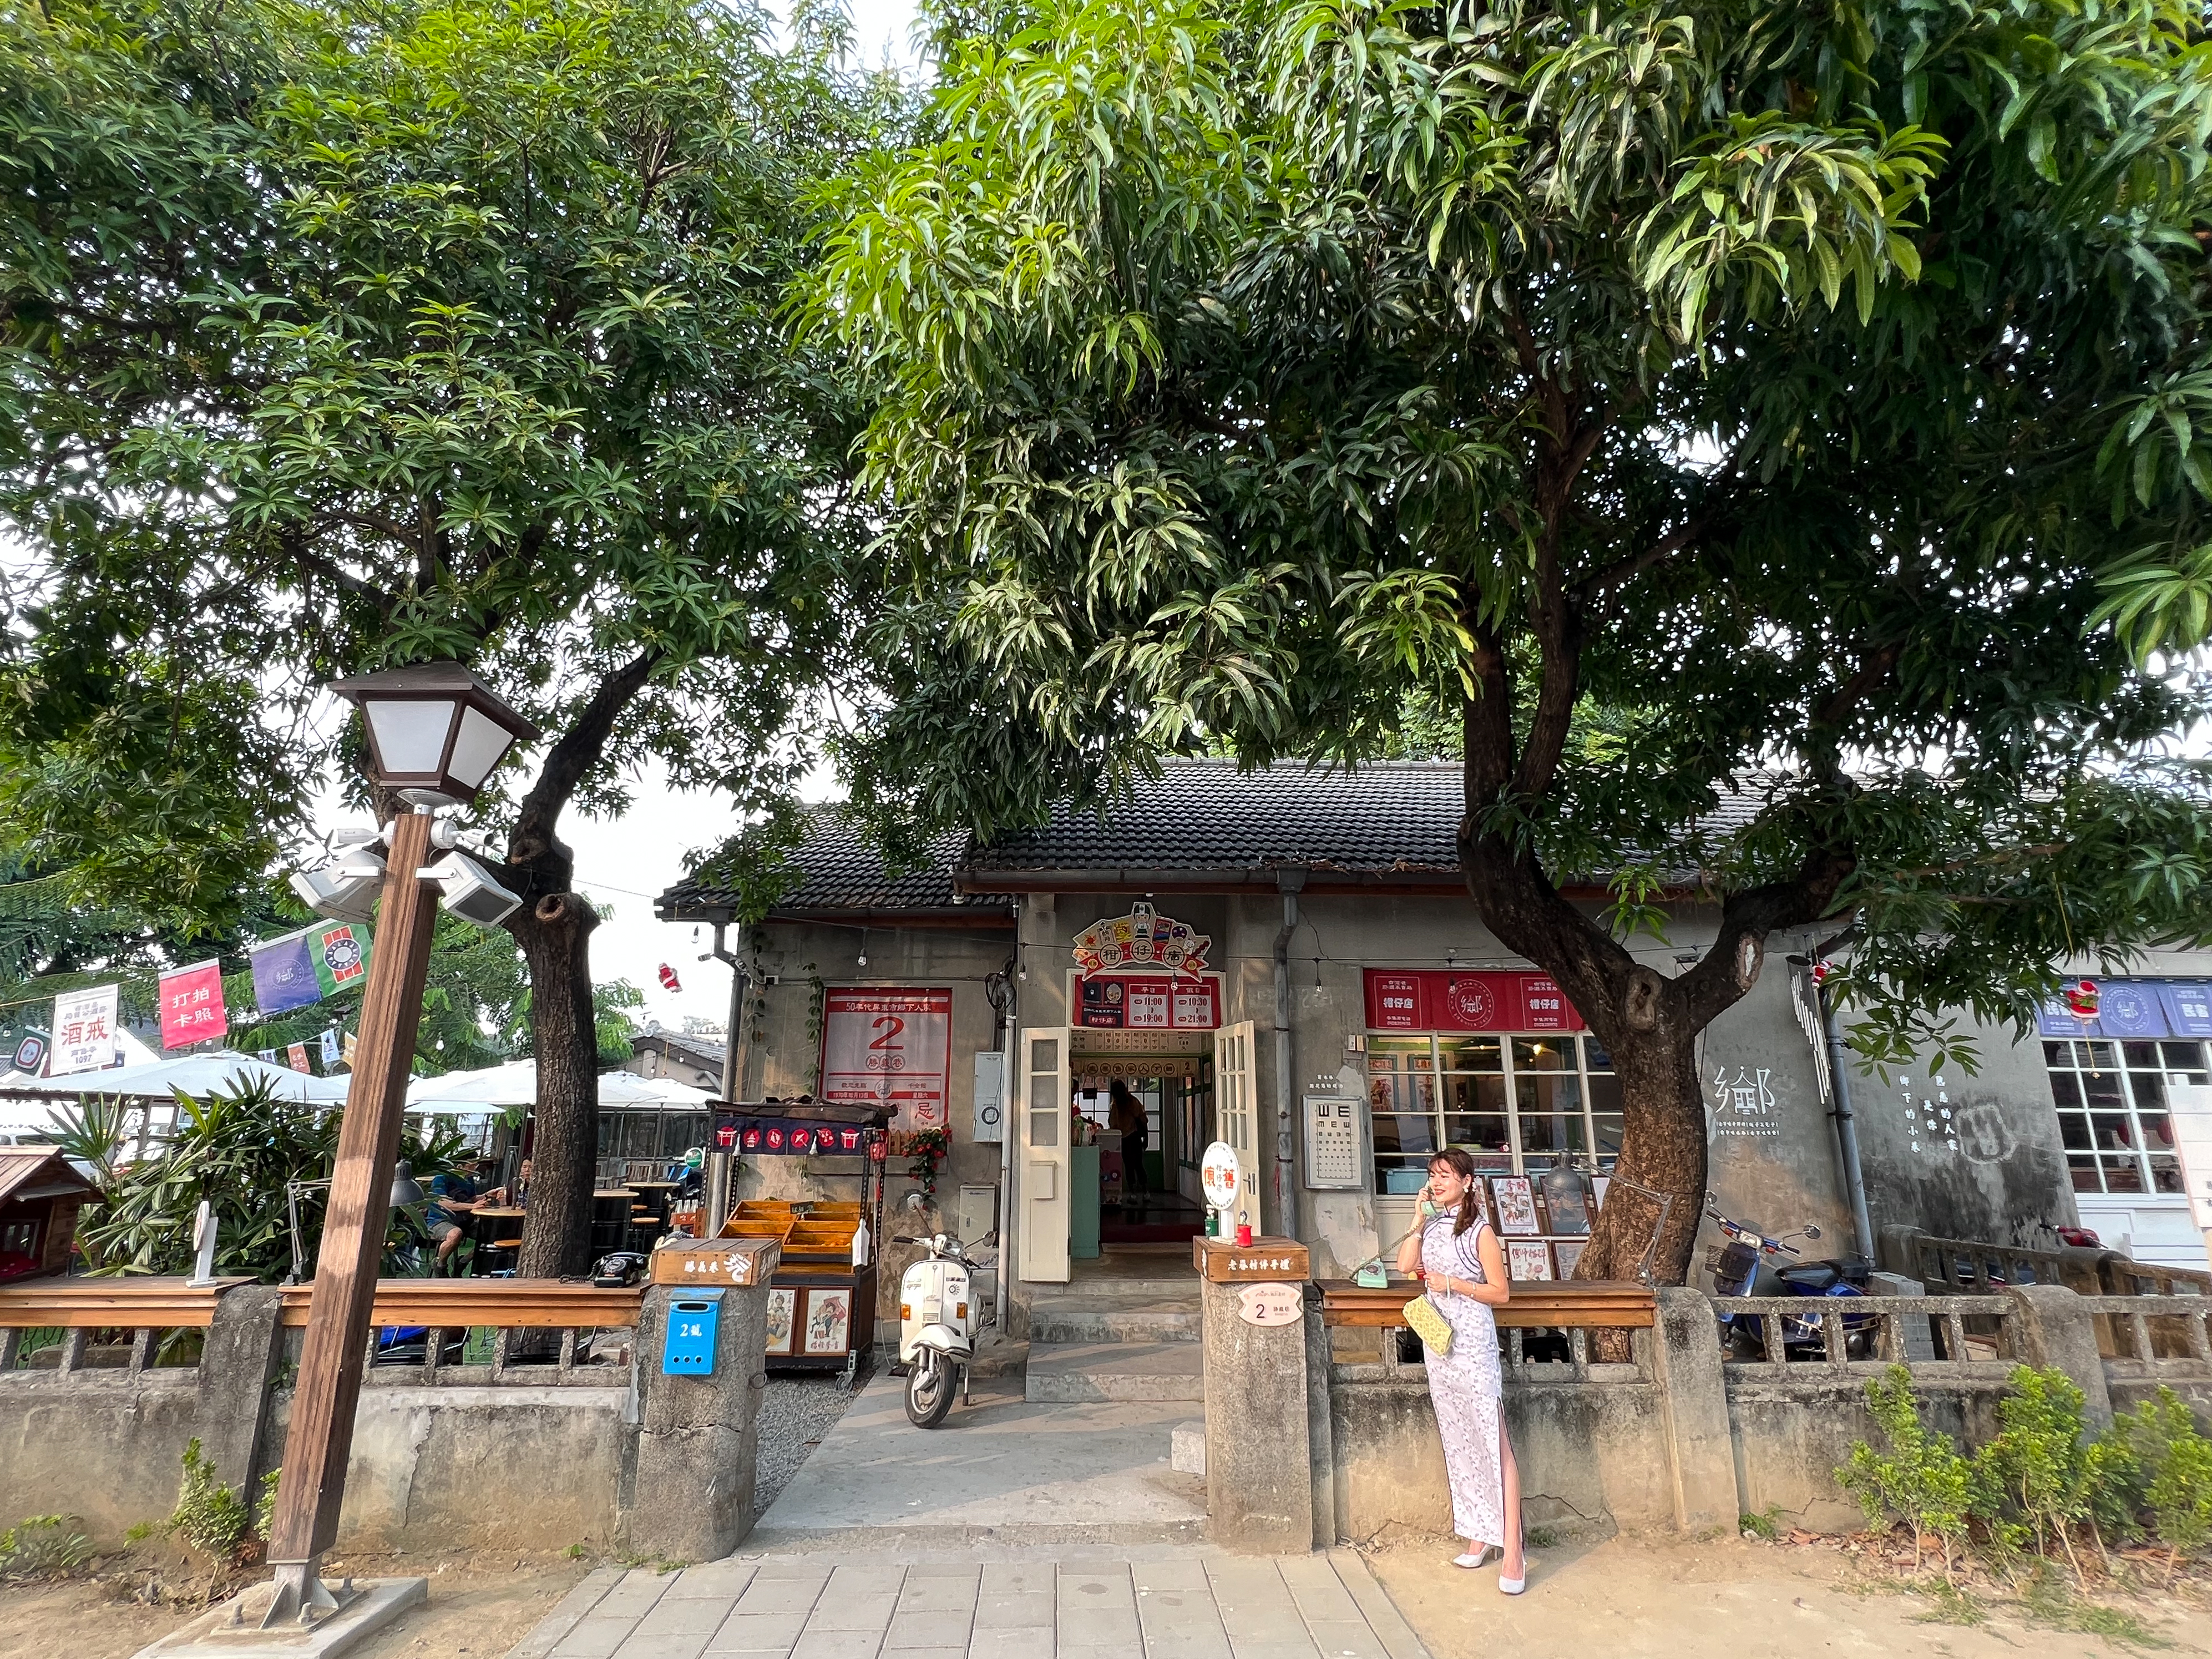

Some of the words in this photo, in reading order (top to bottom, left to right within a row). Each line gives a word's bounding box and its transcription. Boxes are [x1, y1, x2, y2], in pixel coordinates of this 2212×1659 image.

[1102, 943, 1183, 963] 柑仔店
[1144, 997, 1162, 1006] 11:00
[1188, 997, 1207, 1006] 10:30
[1383, 997, 1413, 1009] 柑仔店
[1529, 999, 1559, 1010] 柑仔店
[1143, 1014, 1163, 1023] 19:00
[1188, 1014, 1207, 1023] 21:00
[869, 1015, 905, 1050] 2
[914, 1102, 935, 1120] 忌
[684, 1260, 719, 1273] 勝義巷
[1227, 1258, 1290, 1271] 老眷村伴手禮
[1256, 1304, 1266, 1319] 2
